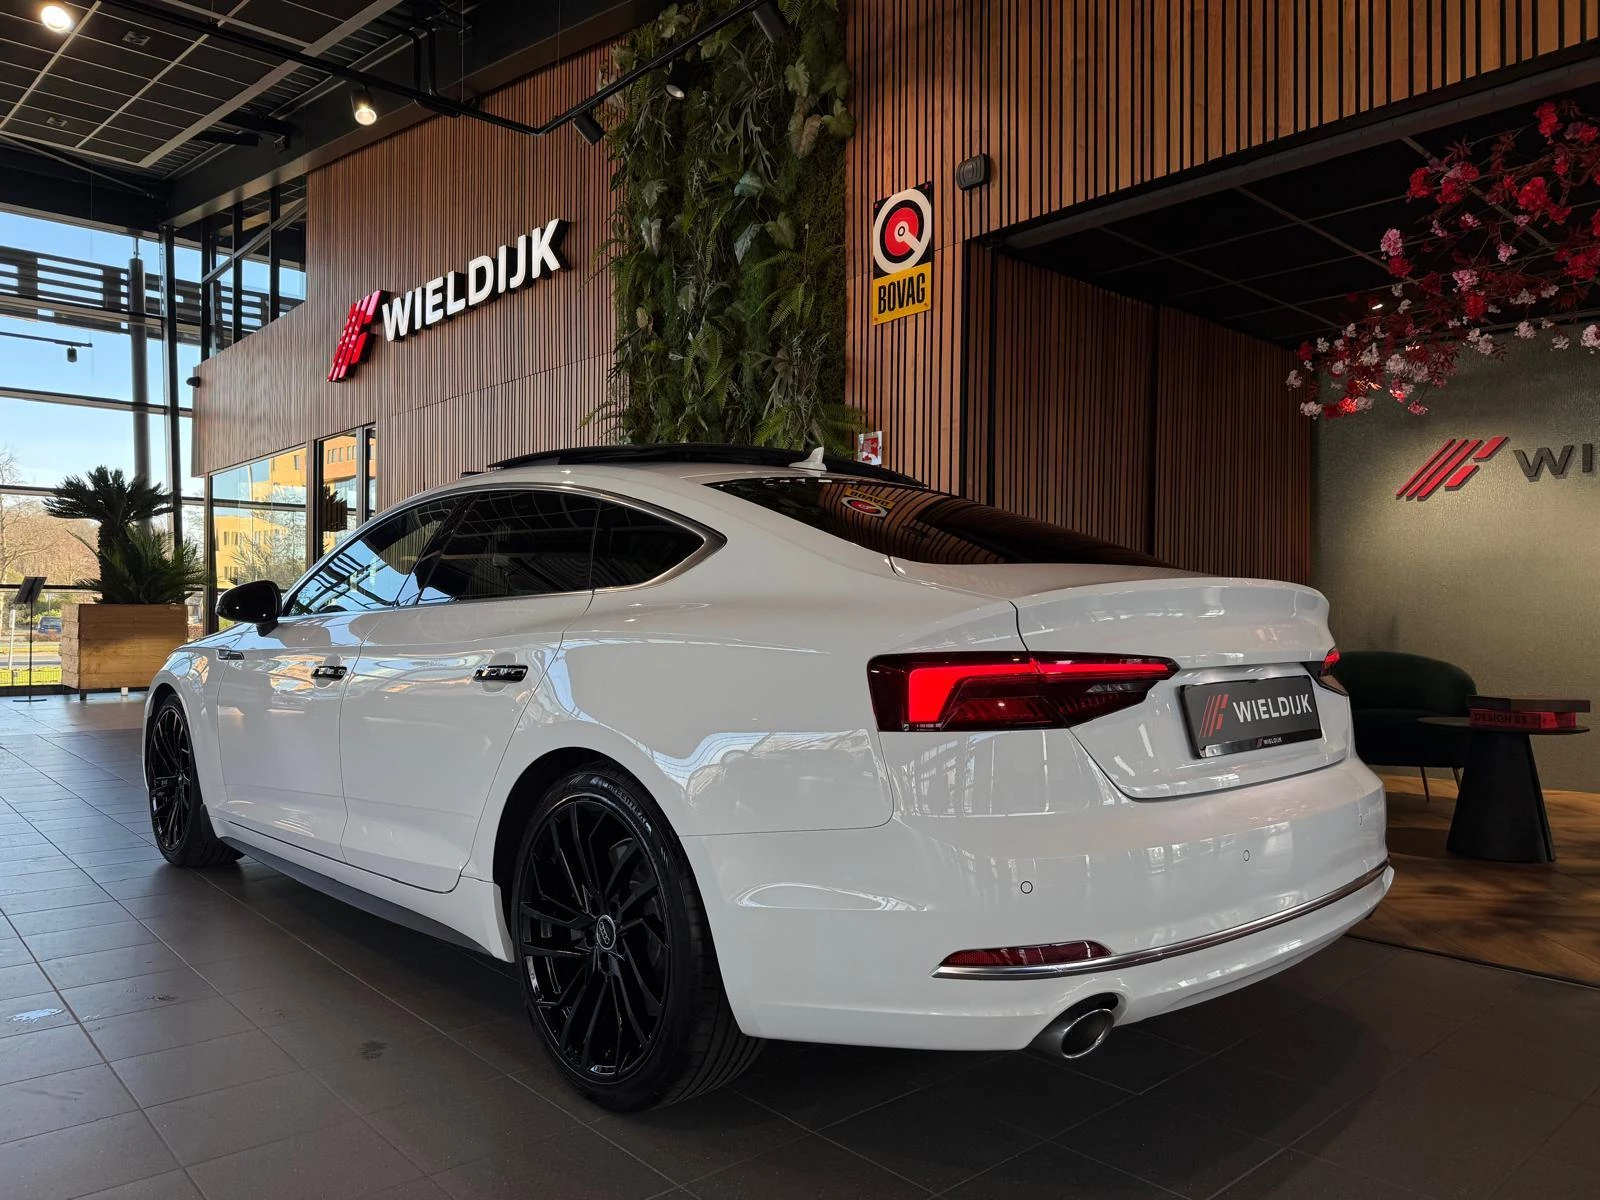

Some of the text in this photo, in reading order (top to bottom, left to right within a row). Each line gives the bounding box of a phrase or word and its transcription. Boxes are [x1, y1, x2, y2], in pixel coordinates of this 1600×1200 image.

[382, 218, 561, 342] WIELDIJK
[877, 272, 926, 315] BOVAG
[1512, 443, 1593, 482] WI
[1232, 693, 1313, 723] WIELDIJK
